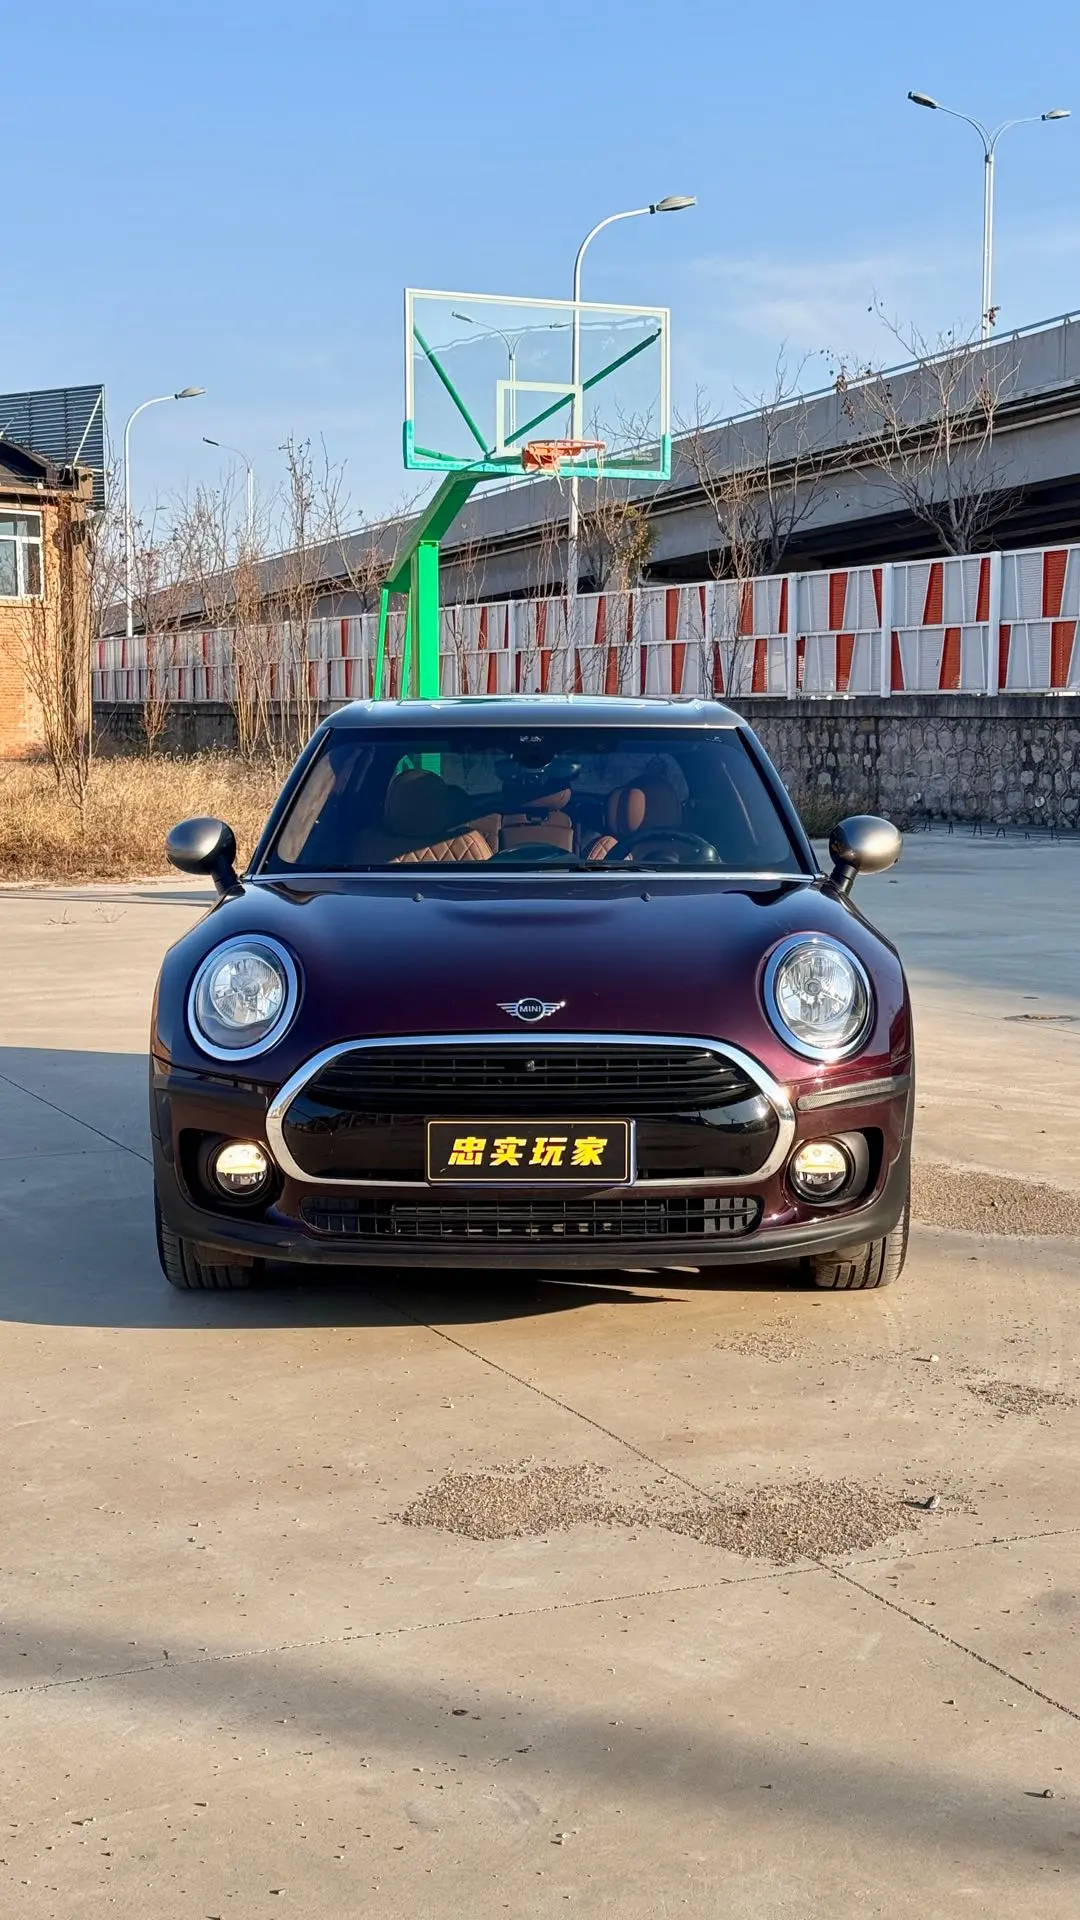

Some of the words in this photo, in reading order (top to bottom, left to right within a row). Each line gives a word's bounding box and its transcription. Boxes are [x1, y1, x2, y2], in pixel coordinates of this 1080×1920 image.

[519, 1005, 542, 1013] MINI
[448, 1136, 608, 1167] 忠实玩家
